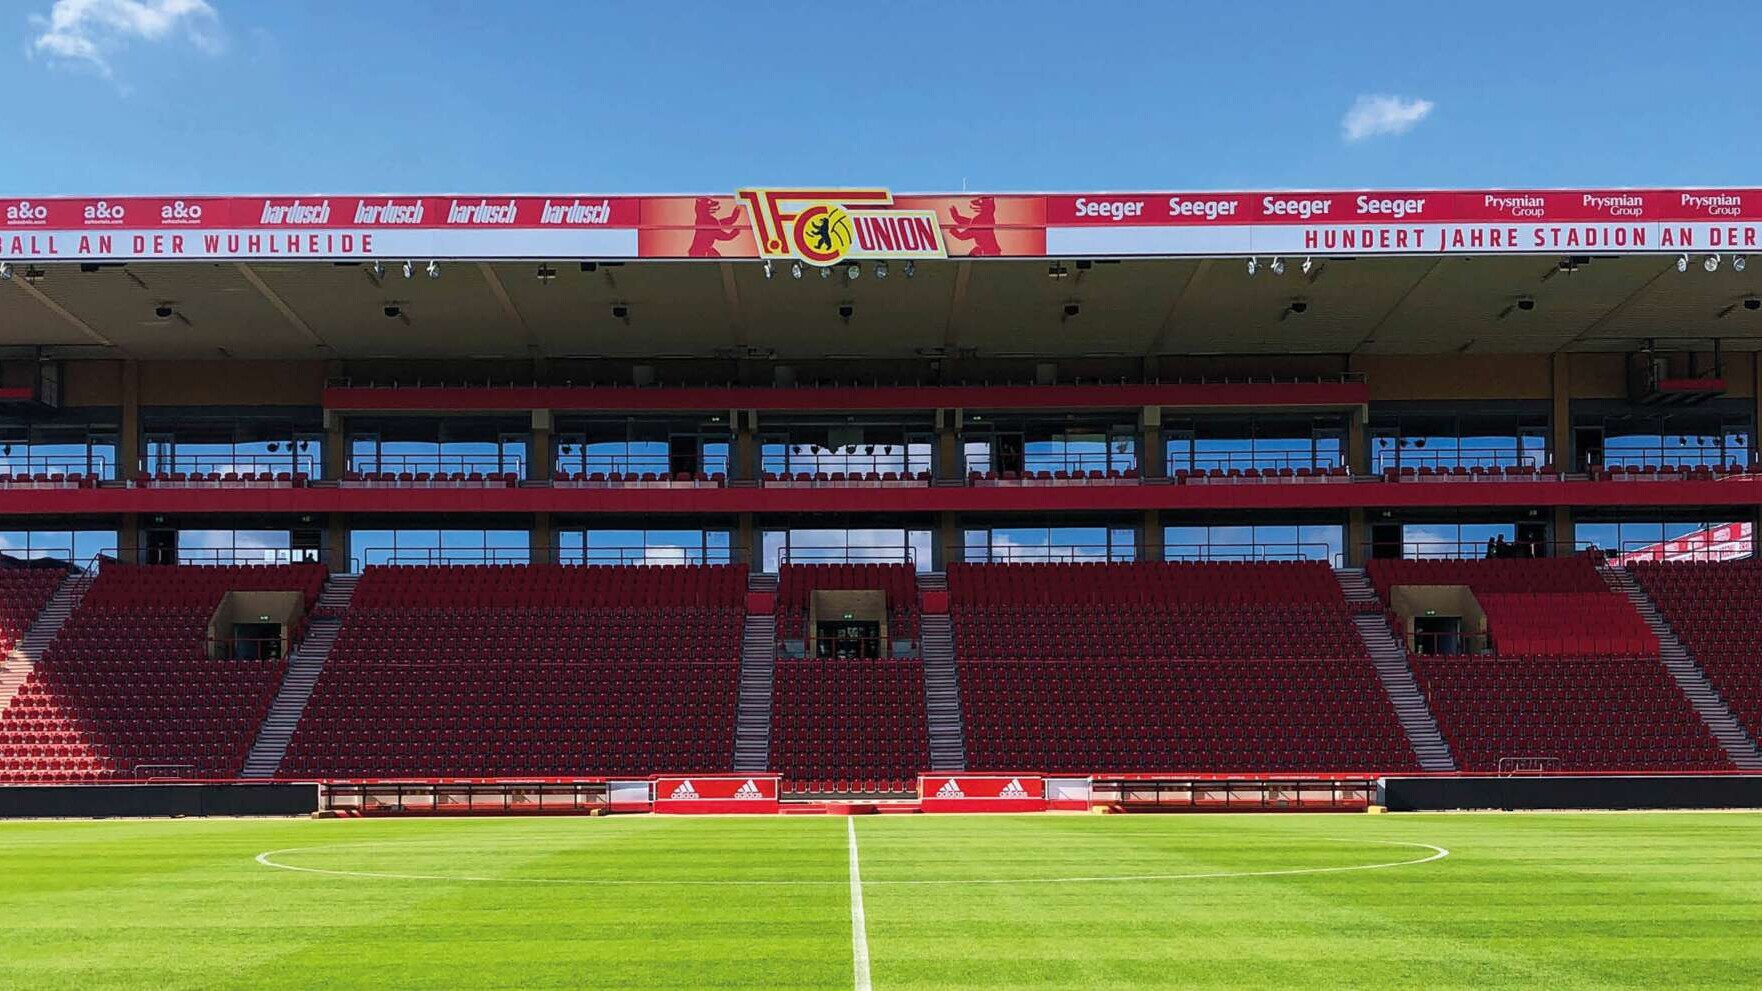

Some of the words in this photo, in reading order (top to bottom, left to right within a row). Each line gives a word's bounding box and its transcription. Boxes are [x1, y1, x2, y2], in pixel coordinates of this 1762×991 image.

[7, 201, 47, 219] a&o
[84, 201, 124, 219] a&o
[161, 201, 201, 218] a&o
[1075, 198, 1144, 221] Seeger
[1169, 197, 1238, 220] Seeger
[1263, 196, 1331, 219] Seeger
[1356, 195, 1425, 218] Seeger
[1484, 195, 1544, 210] Prysmian
[1582, 194, 1642, 209] Prysmian
[1681, 193, 1741, 209] Prysmian
[1511, 206, 1544, 217] Group
[1610, 206, 1642, 217] Group
[1708, 205, 1741, 217] Group
[852, 217, 938, 251] UNION
[1305, 228, 1425, 249] HUNDERT
[1440, 227, 1518, 252] JAHRE
[1534, 227, 1646, 248] STADION
[1661, 227, 1692, 247] AN
[1709, 226, 1756, 246] DER
[0, 235, 58, 254] ALL
[79, 235, 112, 254] AN
[133, 235, 184, 254] DER
[204, 234, 372, 253] WUHLHEIDE
